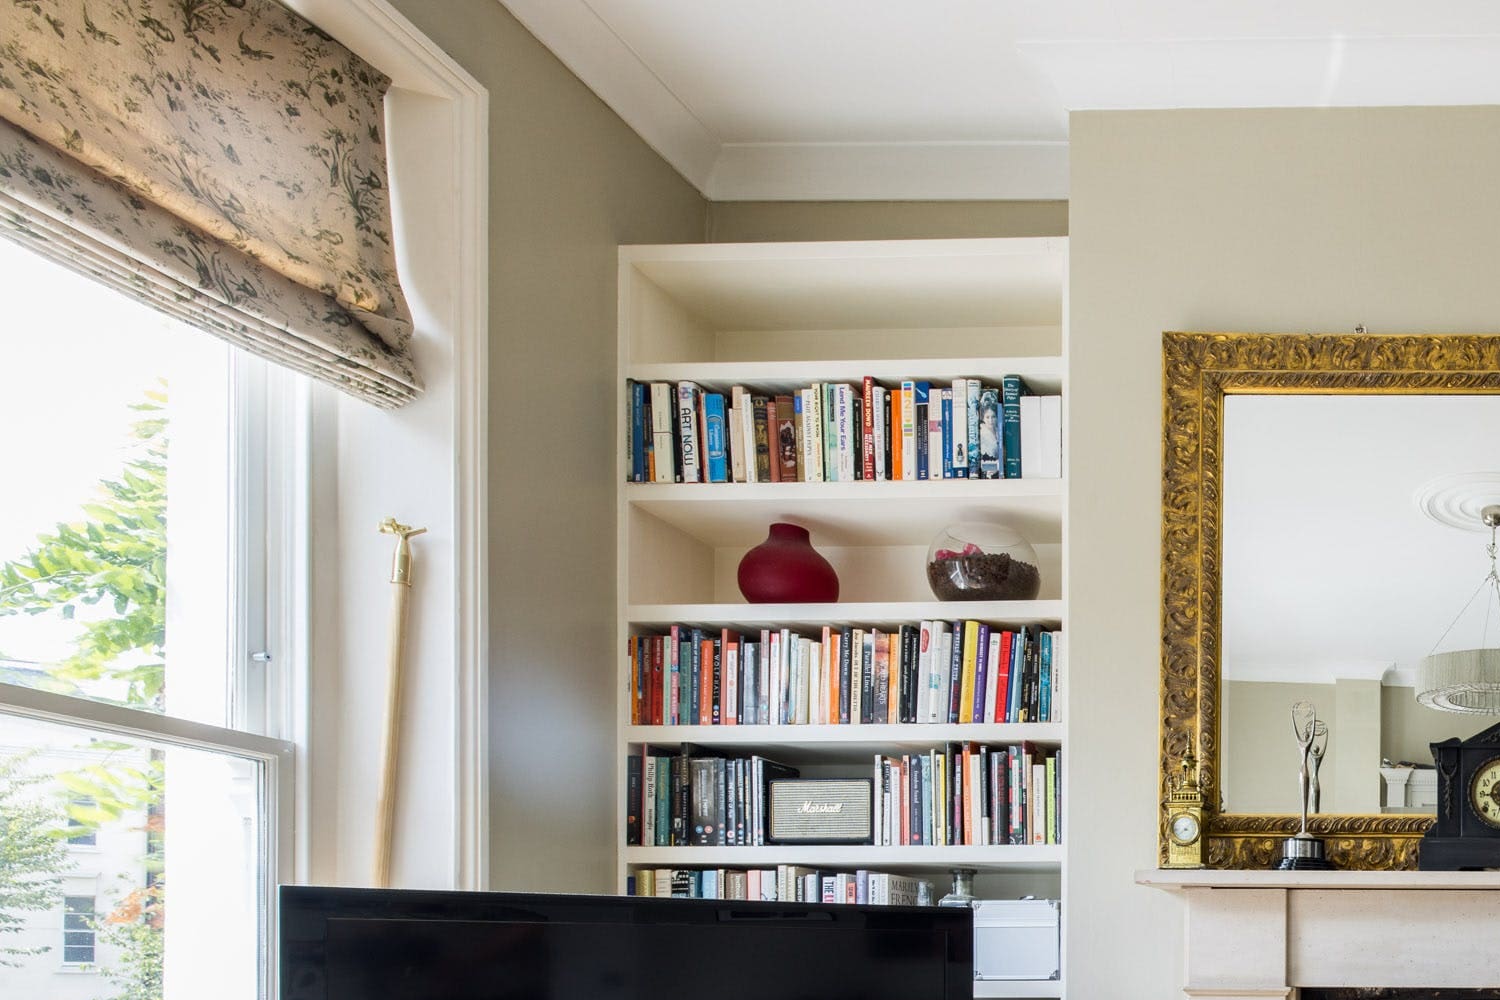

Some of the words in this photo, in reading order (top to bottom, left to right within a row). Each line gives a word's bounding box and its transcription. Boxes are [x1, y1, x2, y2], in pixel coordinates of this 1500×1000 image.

[840, 406, 846, 417] Me
[681, 408, 692, 430] ART
[683, 435, 694, 466] NOW
[844, 649, 849, 658] Me
[797, 800, 844, 813] Marshall
[824, 881, 834, 894] THE
